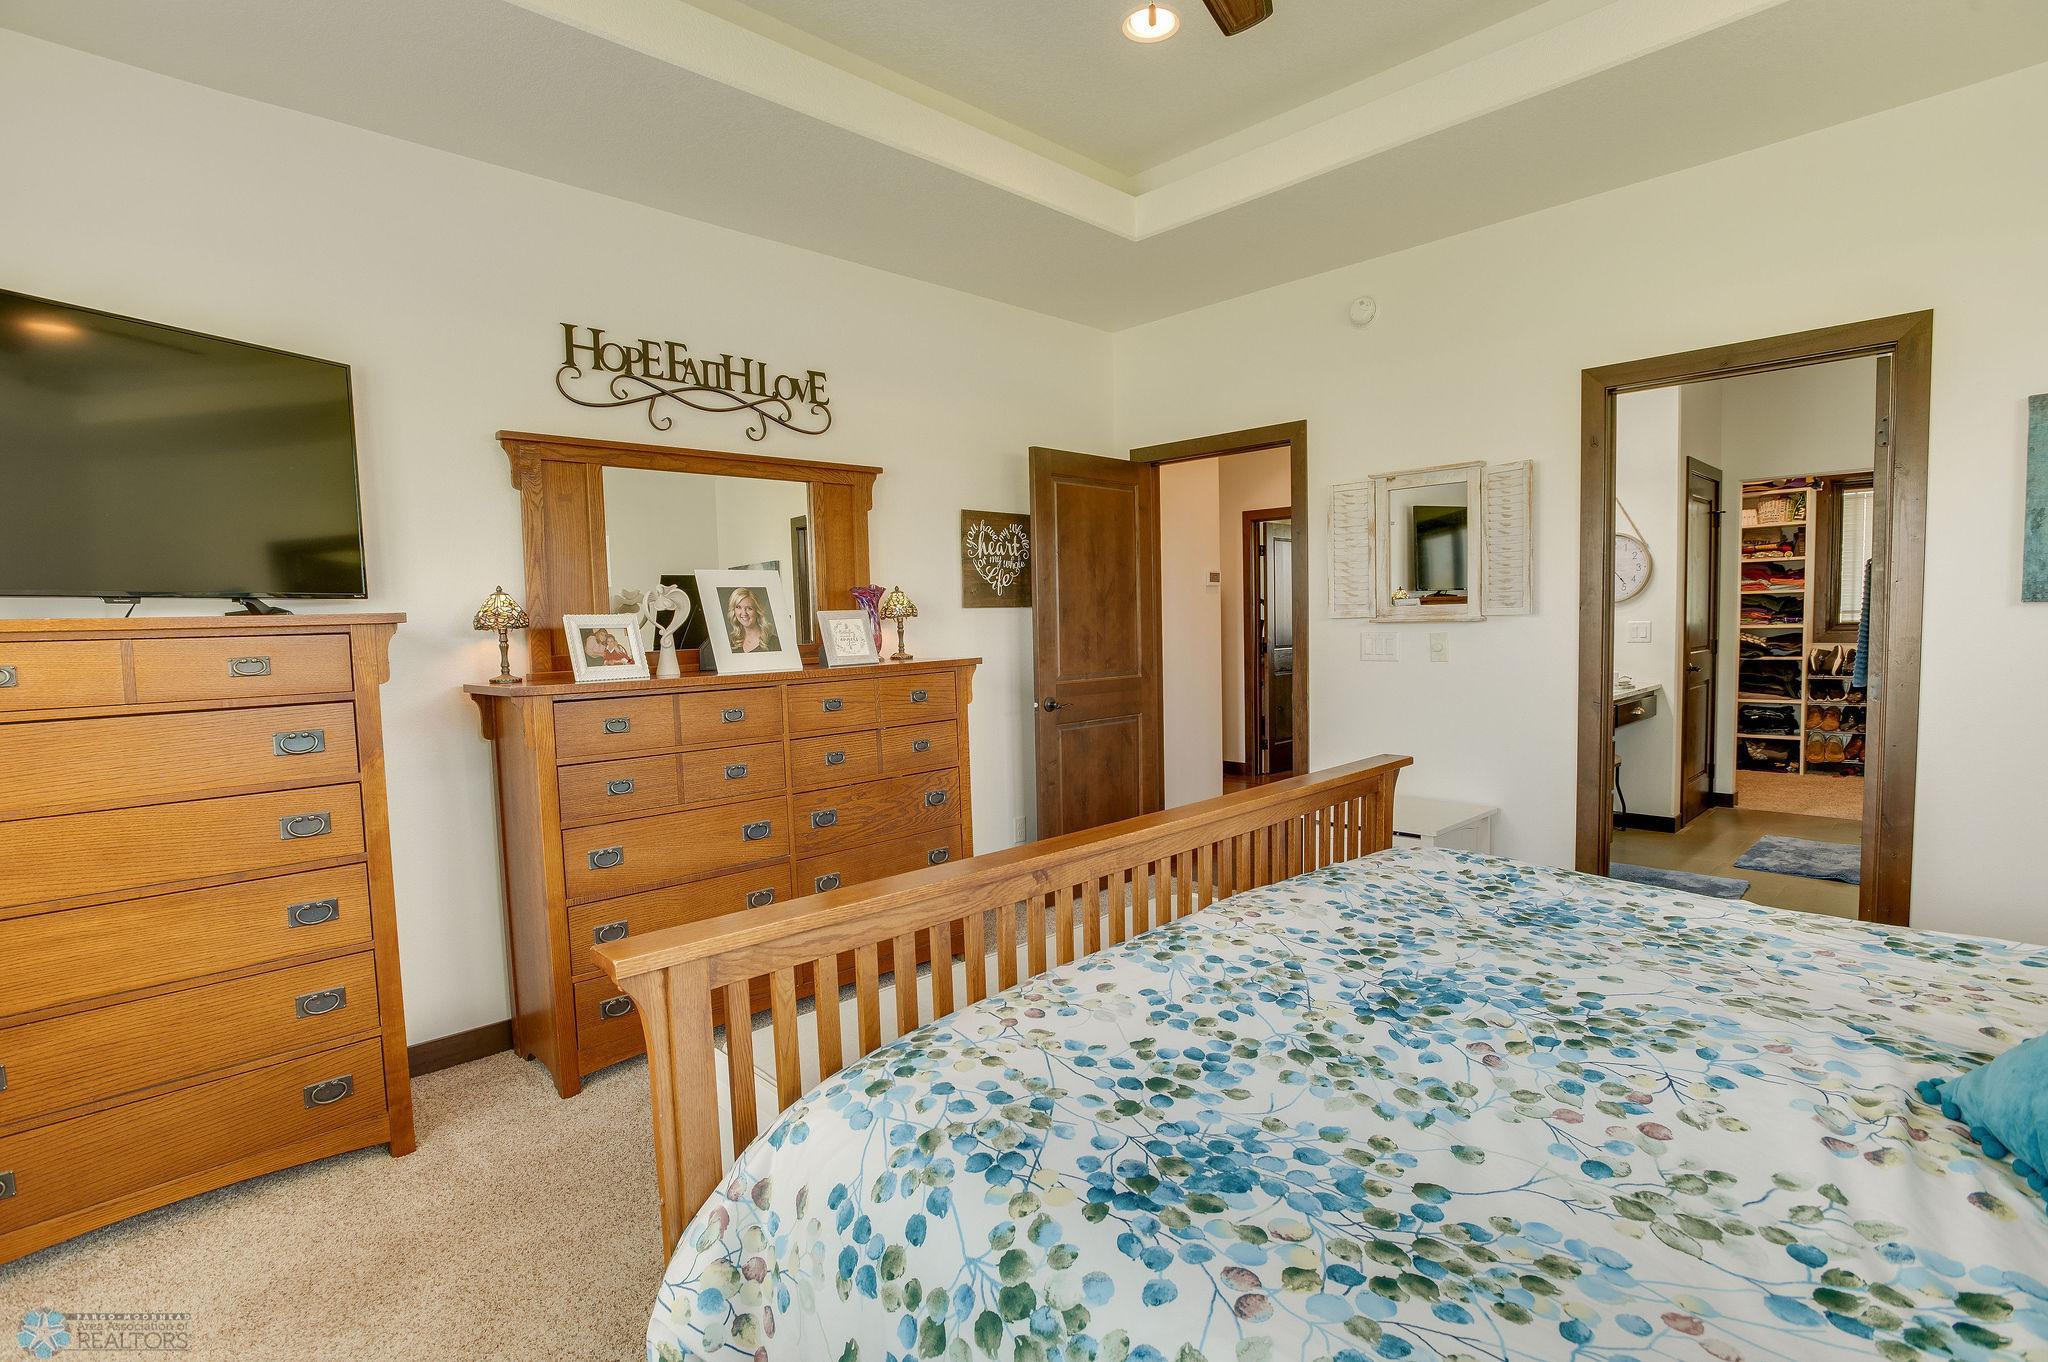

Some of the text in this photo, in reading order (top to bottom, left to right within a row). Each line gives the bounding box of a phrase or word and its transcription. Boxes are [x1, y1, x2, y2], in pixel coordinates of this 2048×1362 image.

[560, 322, 830, 406] HOPE FAITH LOVE
[966, 519, 1030, 550] you have my whole
[968, 531, 1030, 559] heart
